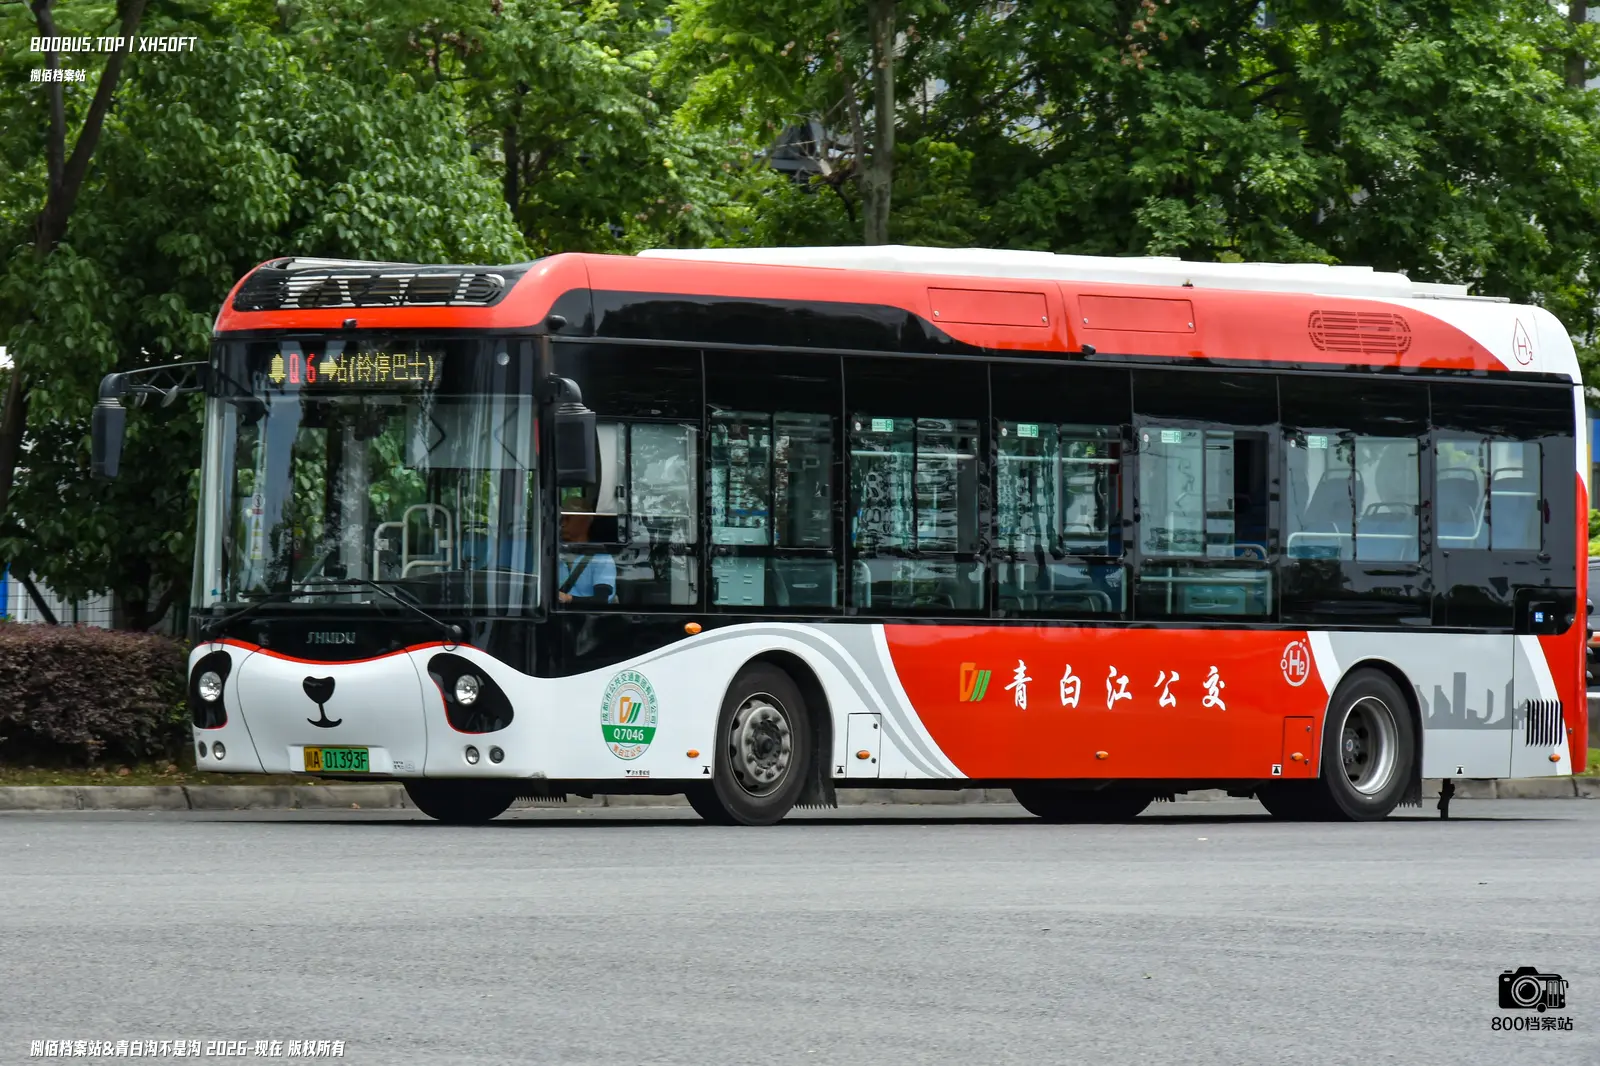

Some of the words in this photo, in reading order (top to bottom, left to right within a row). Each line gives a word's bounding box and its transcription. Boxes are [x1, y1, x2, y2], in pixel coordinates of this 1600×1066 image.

[306, 631, 356, 645] SHUDU
[1004, 659, 1227, 711] 青白江公交
[613, 728, 644, 741] Q7046
